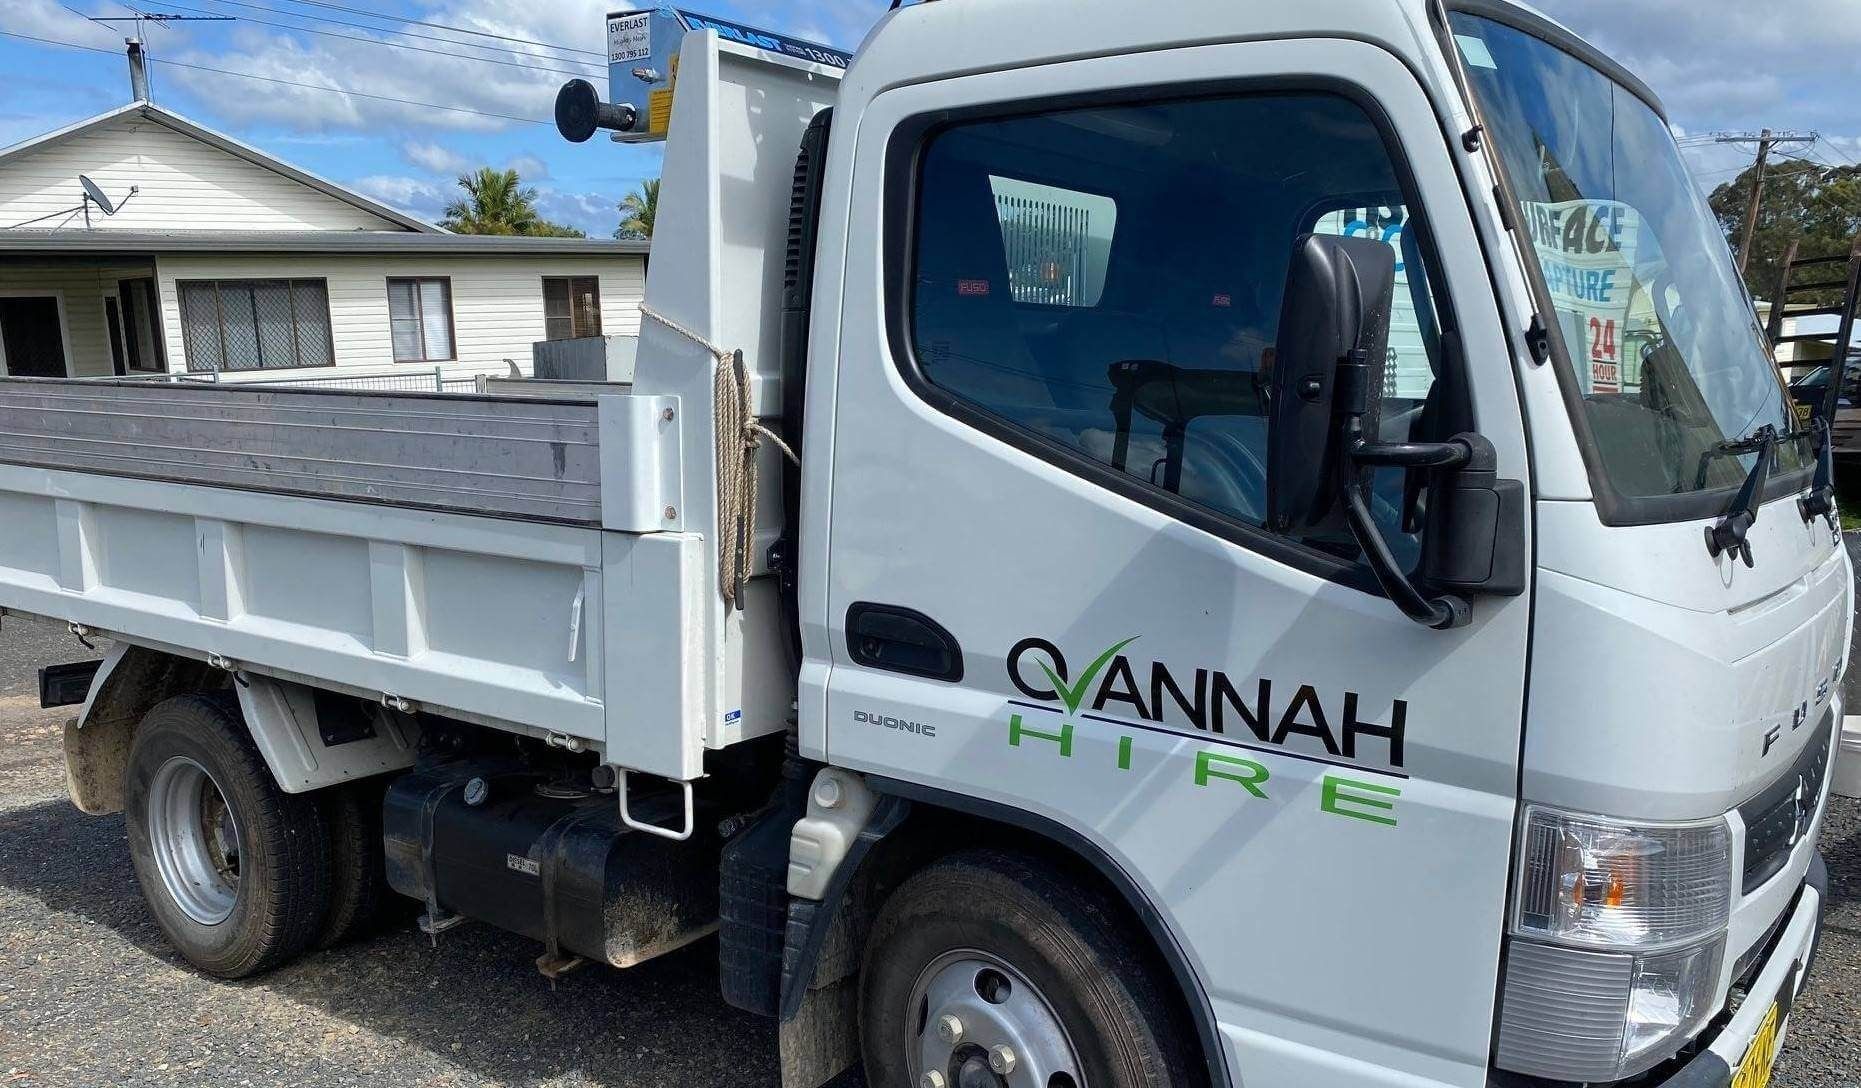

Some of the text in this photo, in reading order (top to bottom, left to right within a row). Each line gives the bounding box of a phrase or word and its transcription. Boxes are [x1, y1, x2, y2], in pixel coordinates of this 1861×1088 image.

[610, 17, 648, 33] EVERLAST
[611, 51, 626, 61] 1300
[638, 47, 649, 57] 112
[805, 48, 846, 68] 1300
[1590, 317, 1616, 361] 24
[1592, 363, 1618, 381] HOUR
[854, 710, 936, 737] DUONIC
[1009, 713, 1402, 827] HIRE
